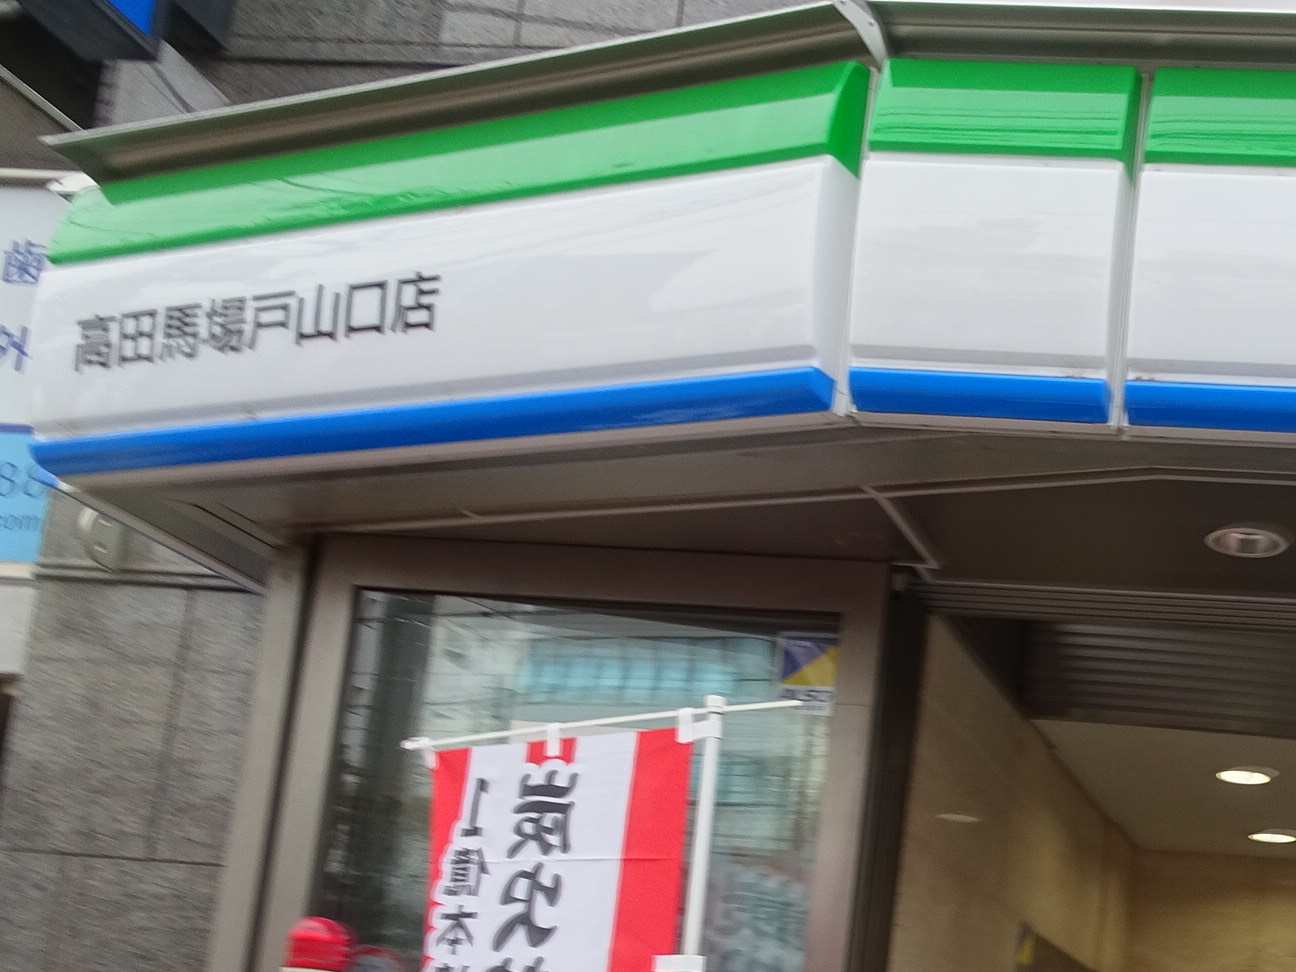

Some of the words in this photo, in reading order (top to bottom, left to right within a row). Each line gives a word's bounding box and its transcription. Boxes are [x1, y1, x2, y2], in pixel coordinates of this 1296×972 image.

[74, 271, 441, 372] 高田馬場戸山口店
